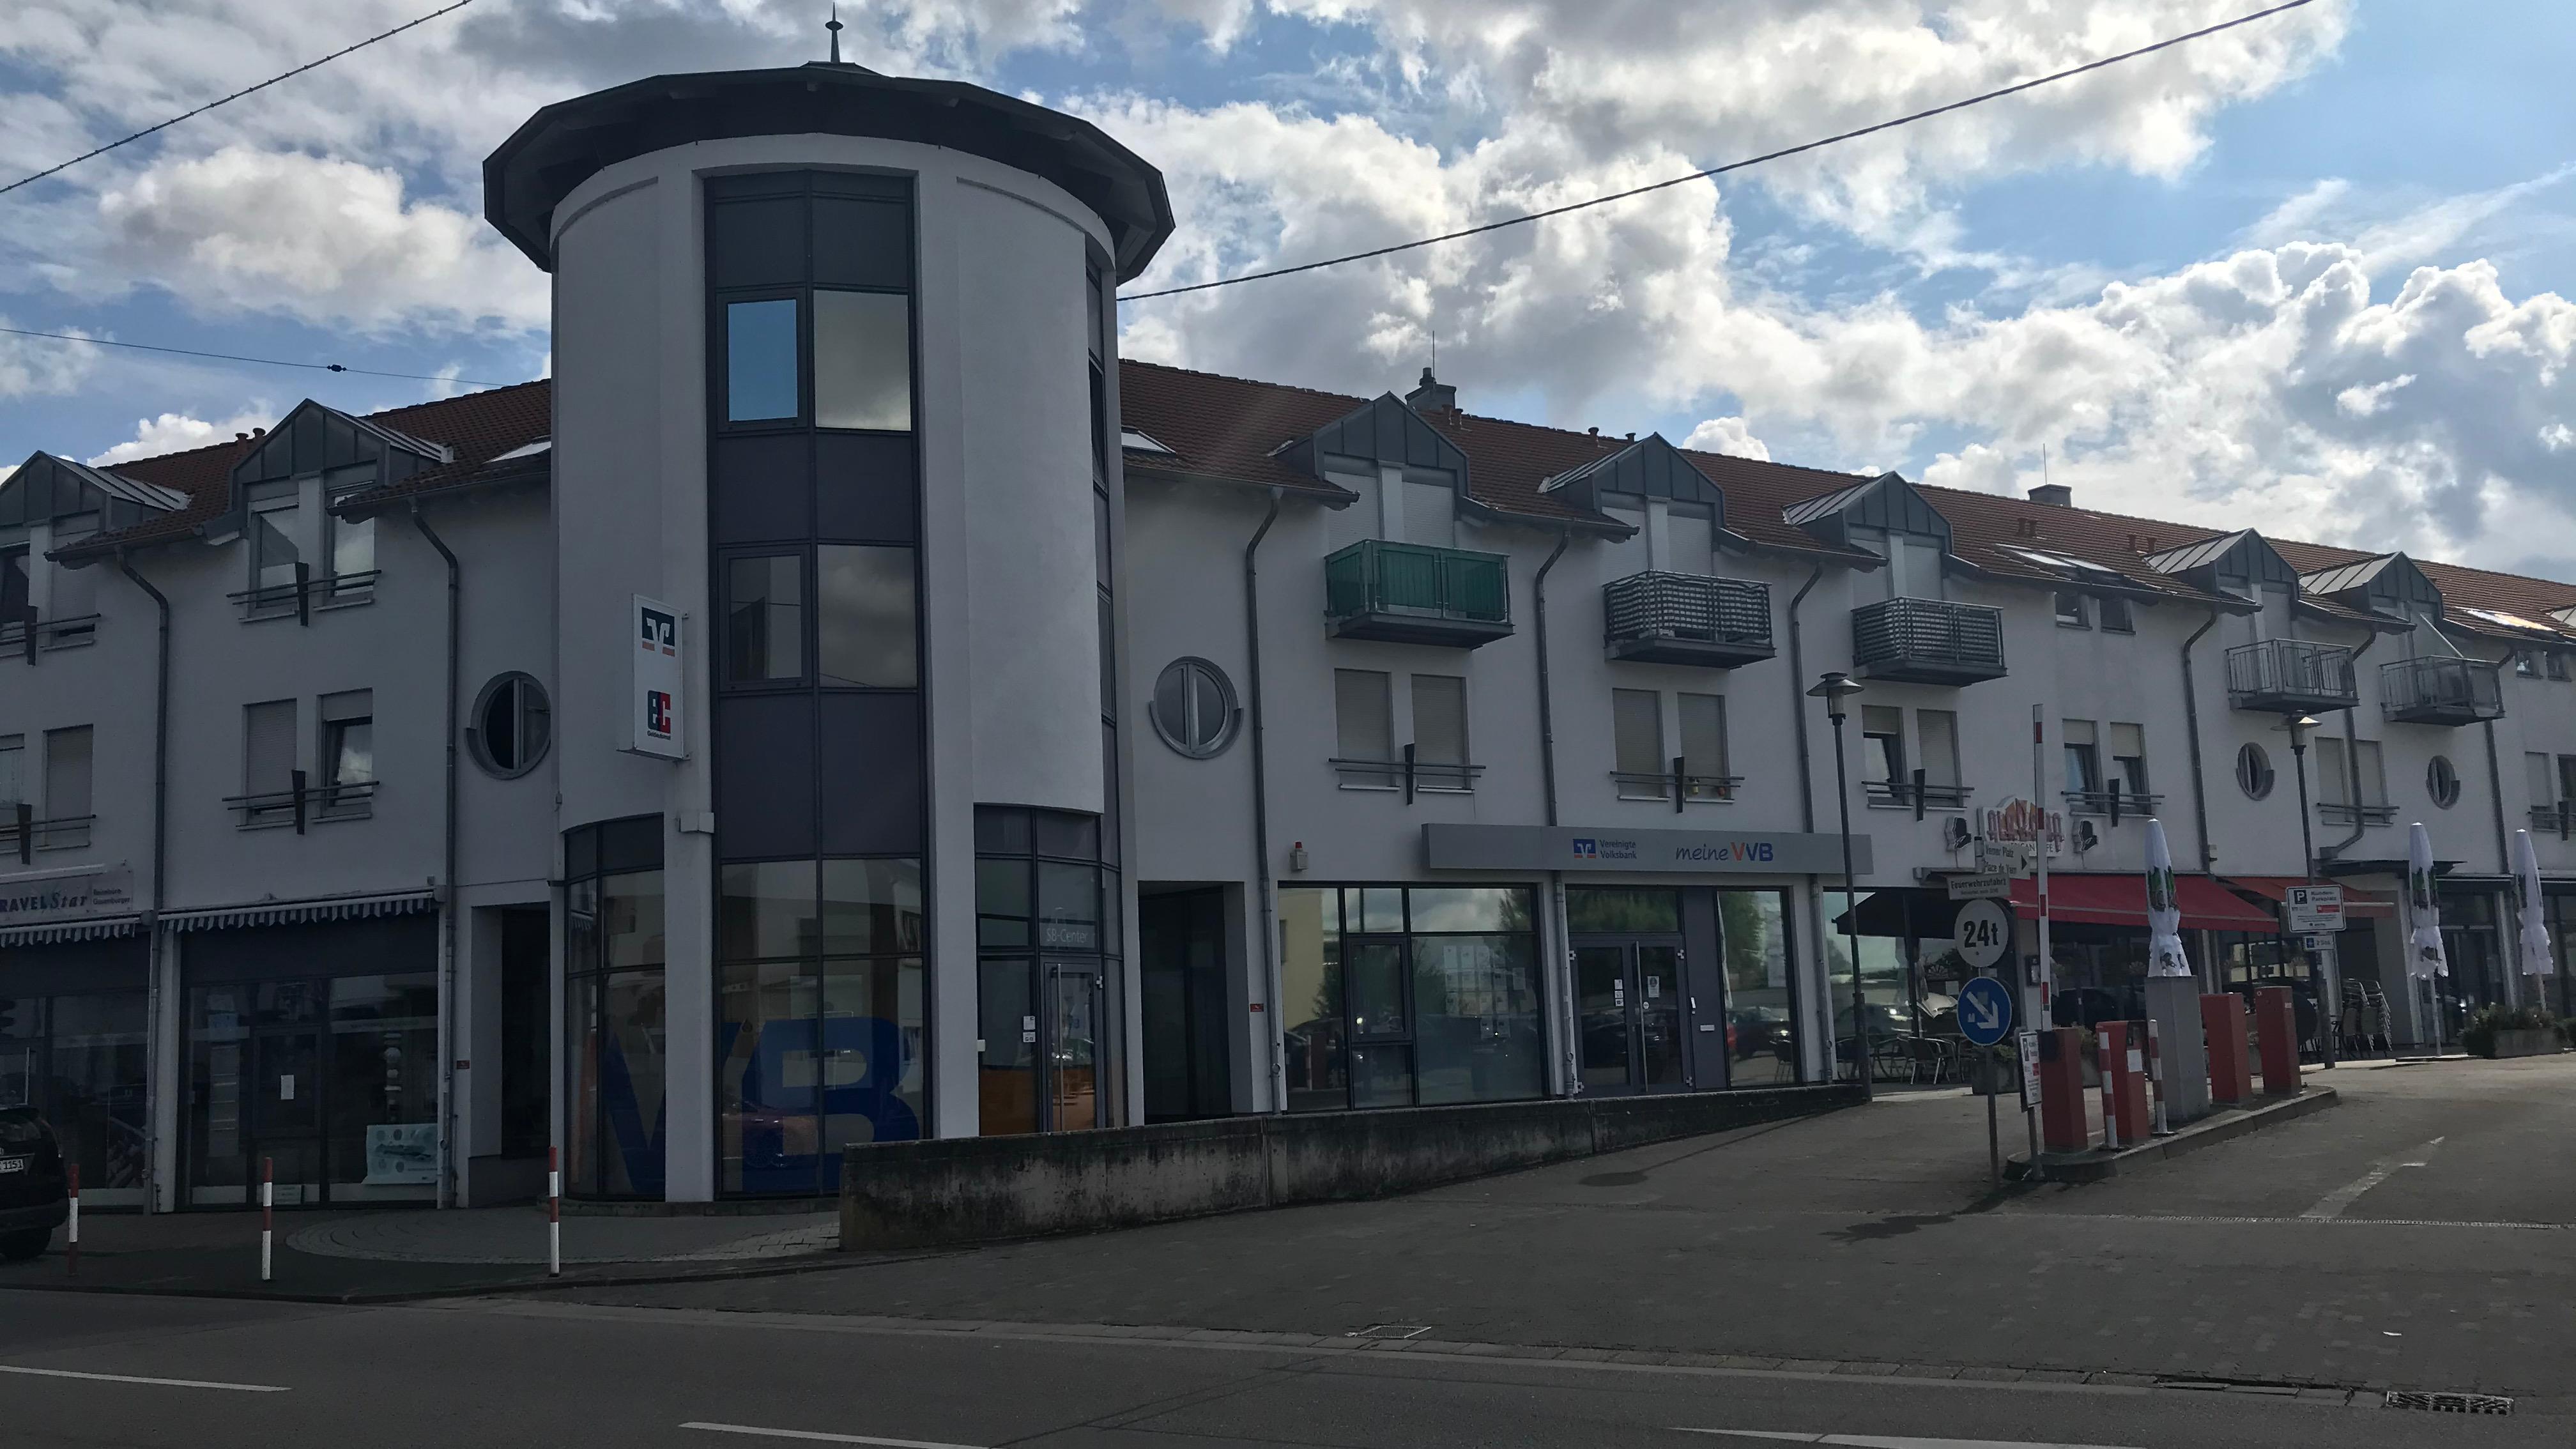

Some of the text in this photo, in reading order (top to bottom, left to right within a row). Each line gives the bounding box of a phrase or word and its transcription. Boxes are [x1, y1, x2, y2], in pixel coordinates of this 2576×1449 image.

[1599, 839, 1636, 850] Vereinigte
[1600, 850, 1637, 859] Volksbank
[1675, 842, 1774, 862] meine VVB
[1951, 877, 2007, 889] Feuerwehrzufahrt
[1046, 928, 1089, 944] SB-Center
